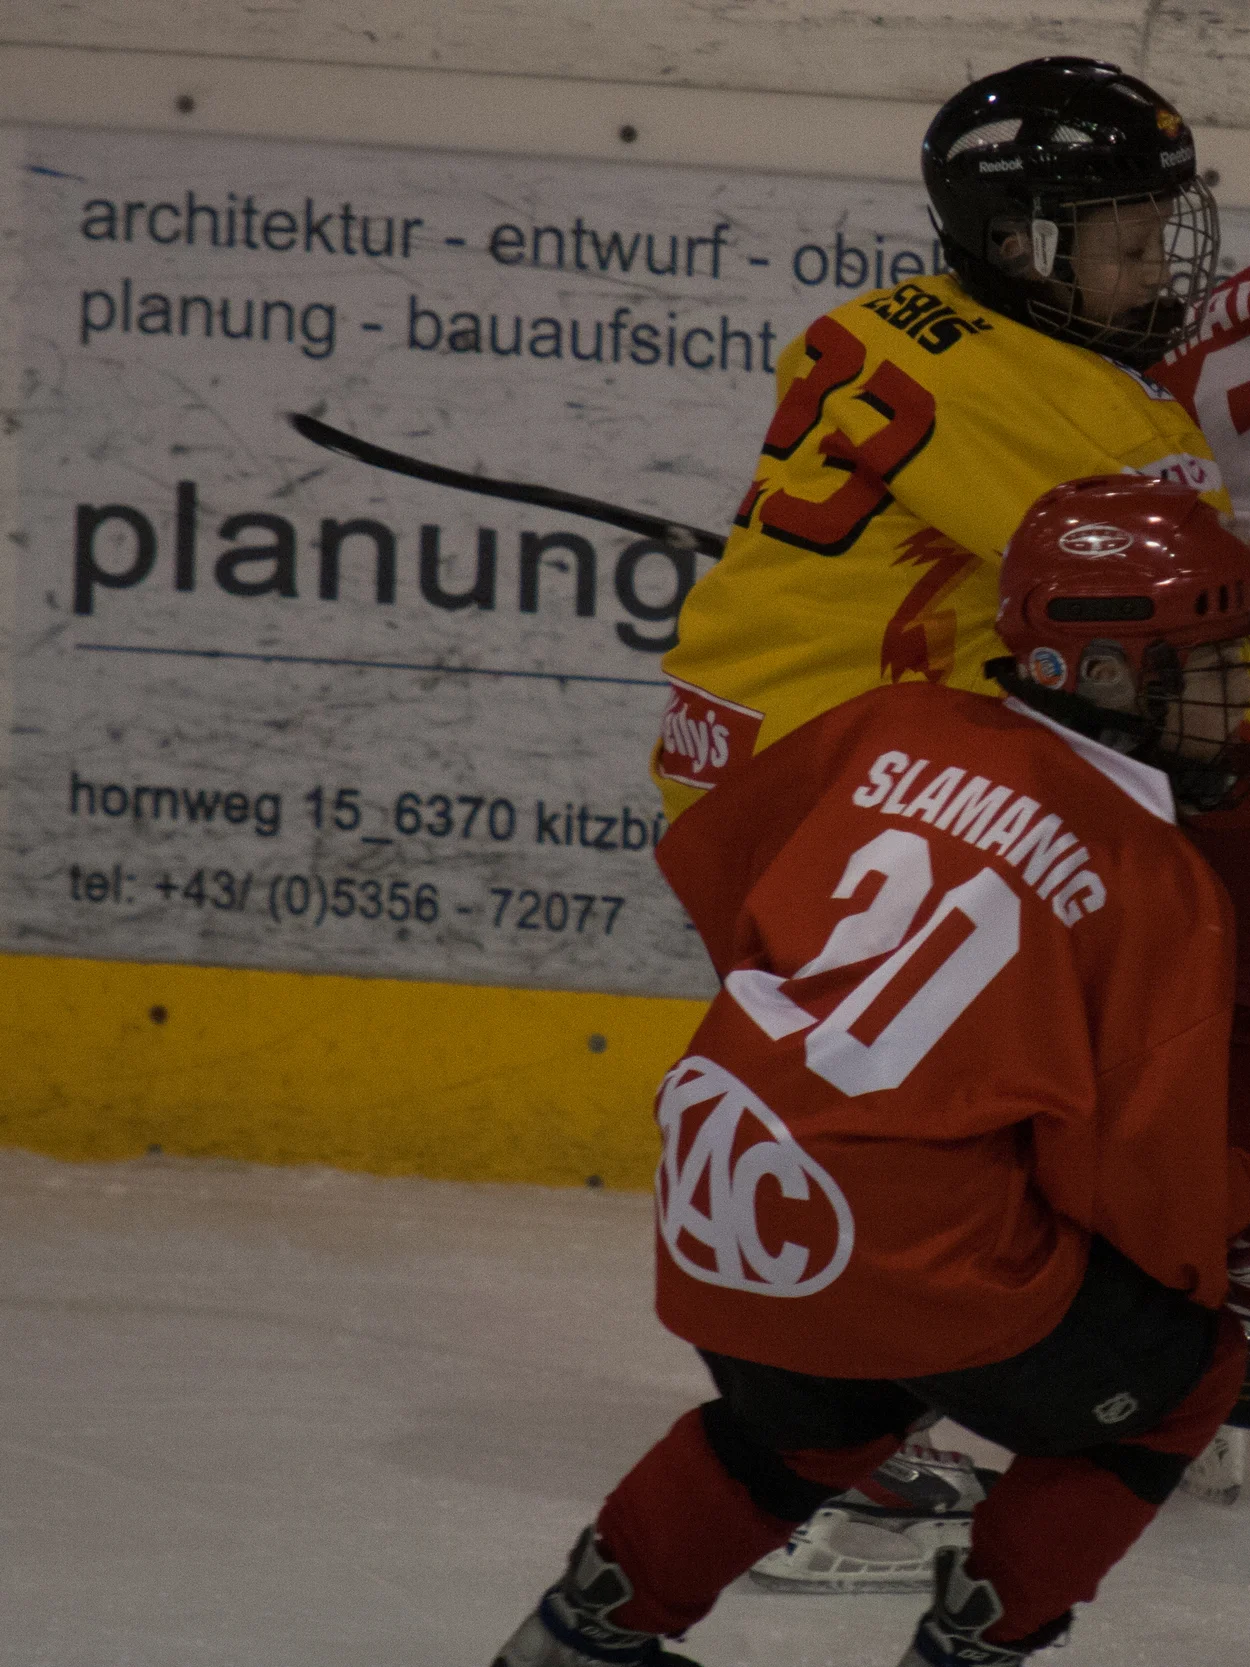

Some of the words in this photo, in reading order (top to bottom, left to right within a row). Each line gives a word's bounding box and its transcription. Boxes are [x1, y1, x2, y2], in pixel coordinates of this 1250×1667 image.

[978, 157, 1025, 174] Reebok
[81, 191, 424, 257] architektur
[490, 217, 729, 279] entwurf
[81, 277, 336, 359] planung
[409, 295, 778, 374] bauaufsicht
[75, 480, 696, 652] planung
[69, 772, 283, 837] hornweg
[852, 749, 1108, 928] SLAMANIG
[69, 864, 137, 904] tel:
[268, 874, 440, 926] (0)5356
[490, 887, 626, 935] 72077
[723, 828, 1022, 1098] 20
